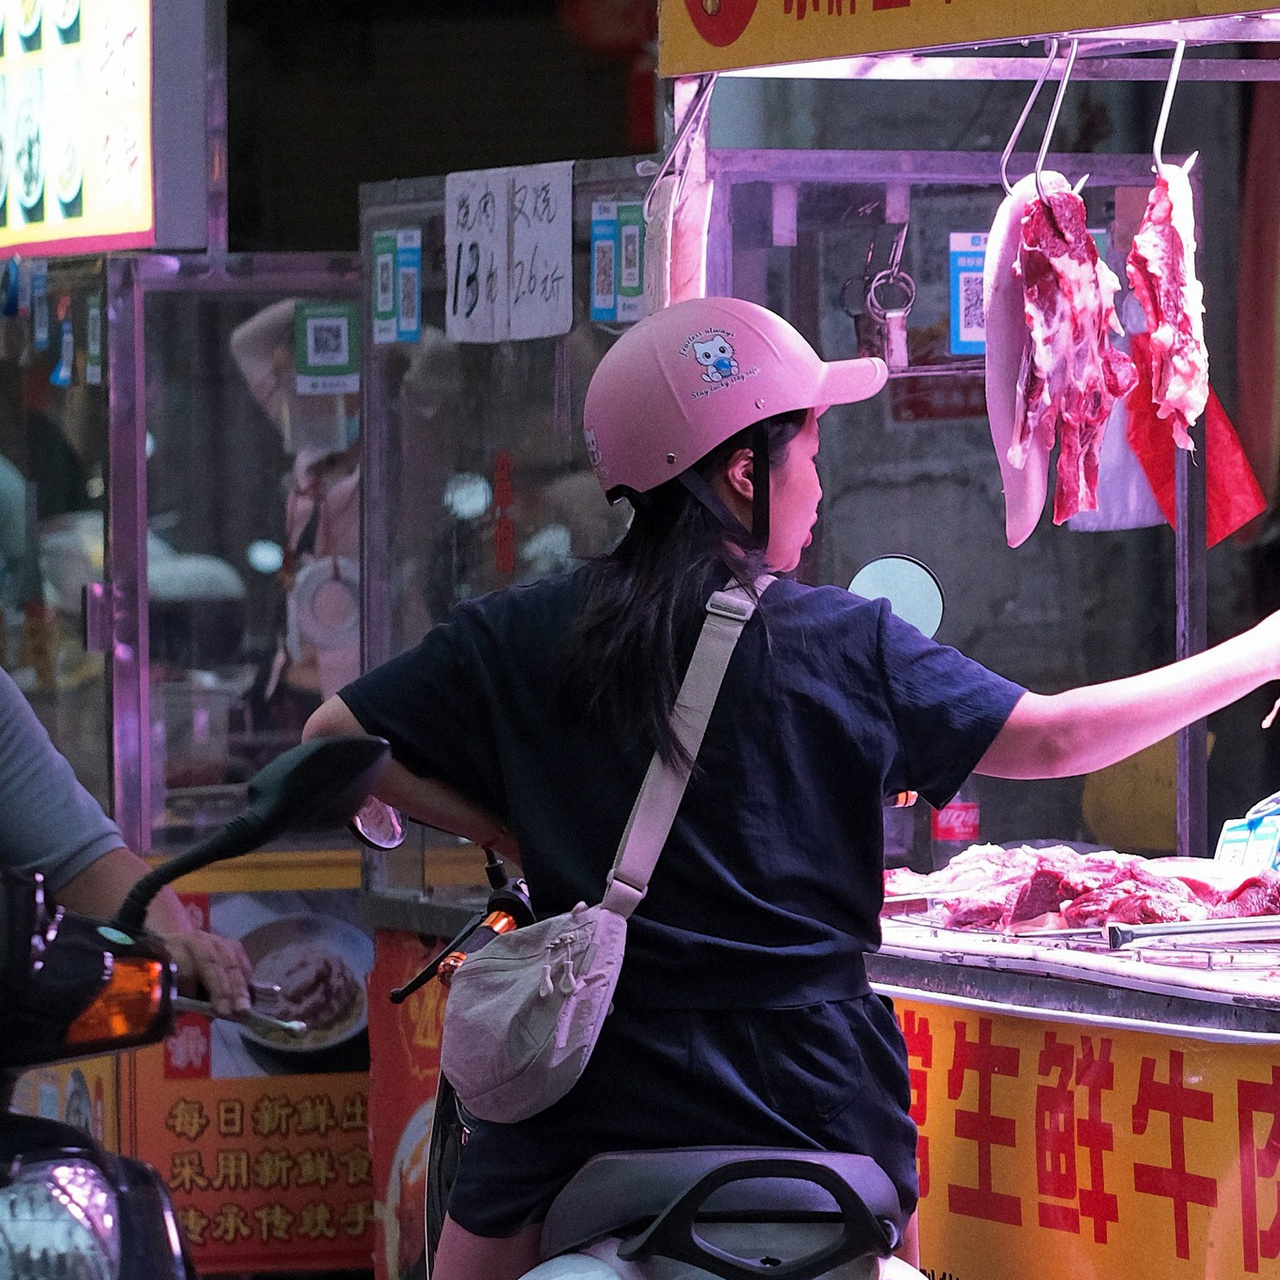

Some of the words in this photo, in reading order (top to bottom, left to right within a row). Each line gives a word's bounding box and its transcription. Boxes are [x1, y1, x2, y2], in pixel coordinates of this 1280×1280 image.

[705, 327, 735, 338] always
[691, 388, 710, 400] Stay
[710, 379, 730, 392] lucky
[731, 373, 745, 384] stay
